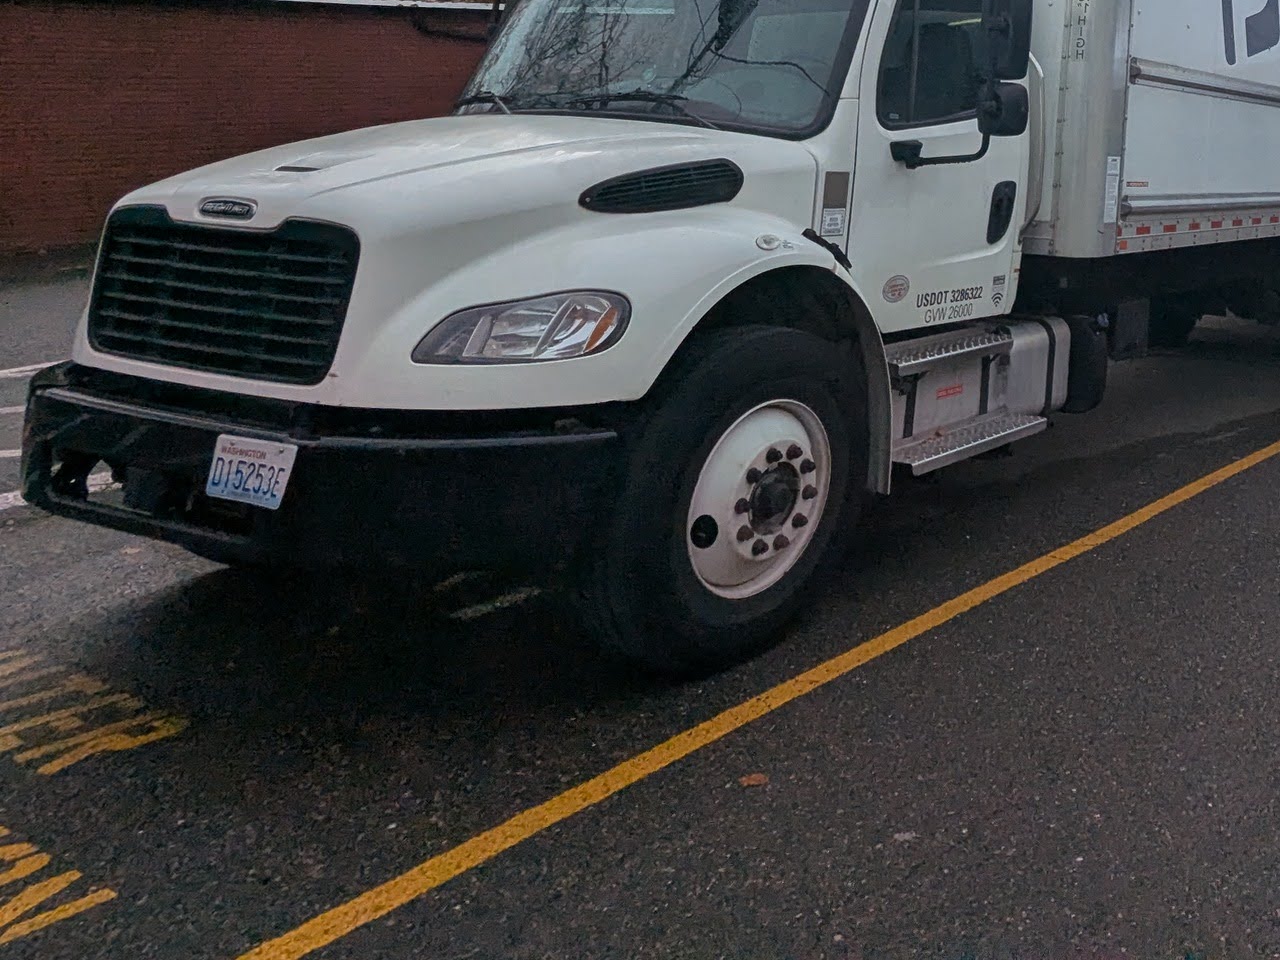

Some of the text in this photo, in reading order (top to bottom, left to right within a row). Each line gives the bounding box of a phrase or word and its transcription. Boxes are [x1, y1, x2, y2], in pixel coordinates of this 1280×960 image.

[916, 286, 983, 308] USDOT 3286322
[924, 303, 973, 323] GVW 26000
[221, 446, 267, 460] WASHINGTON
